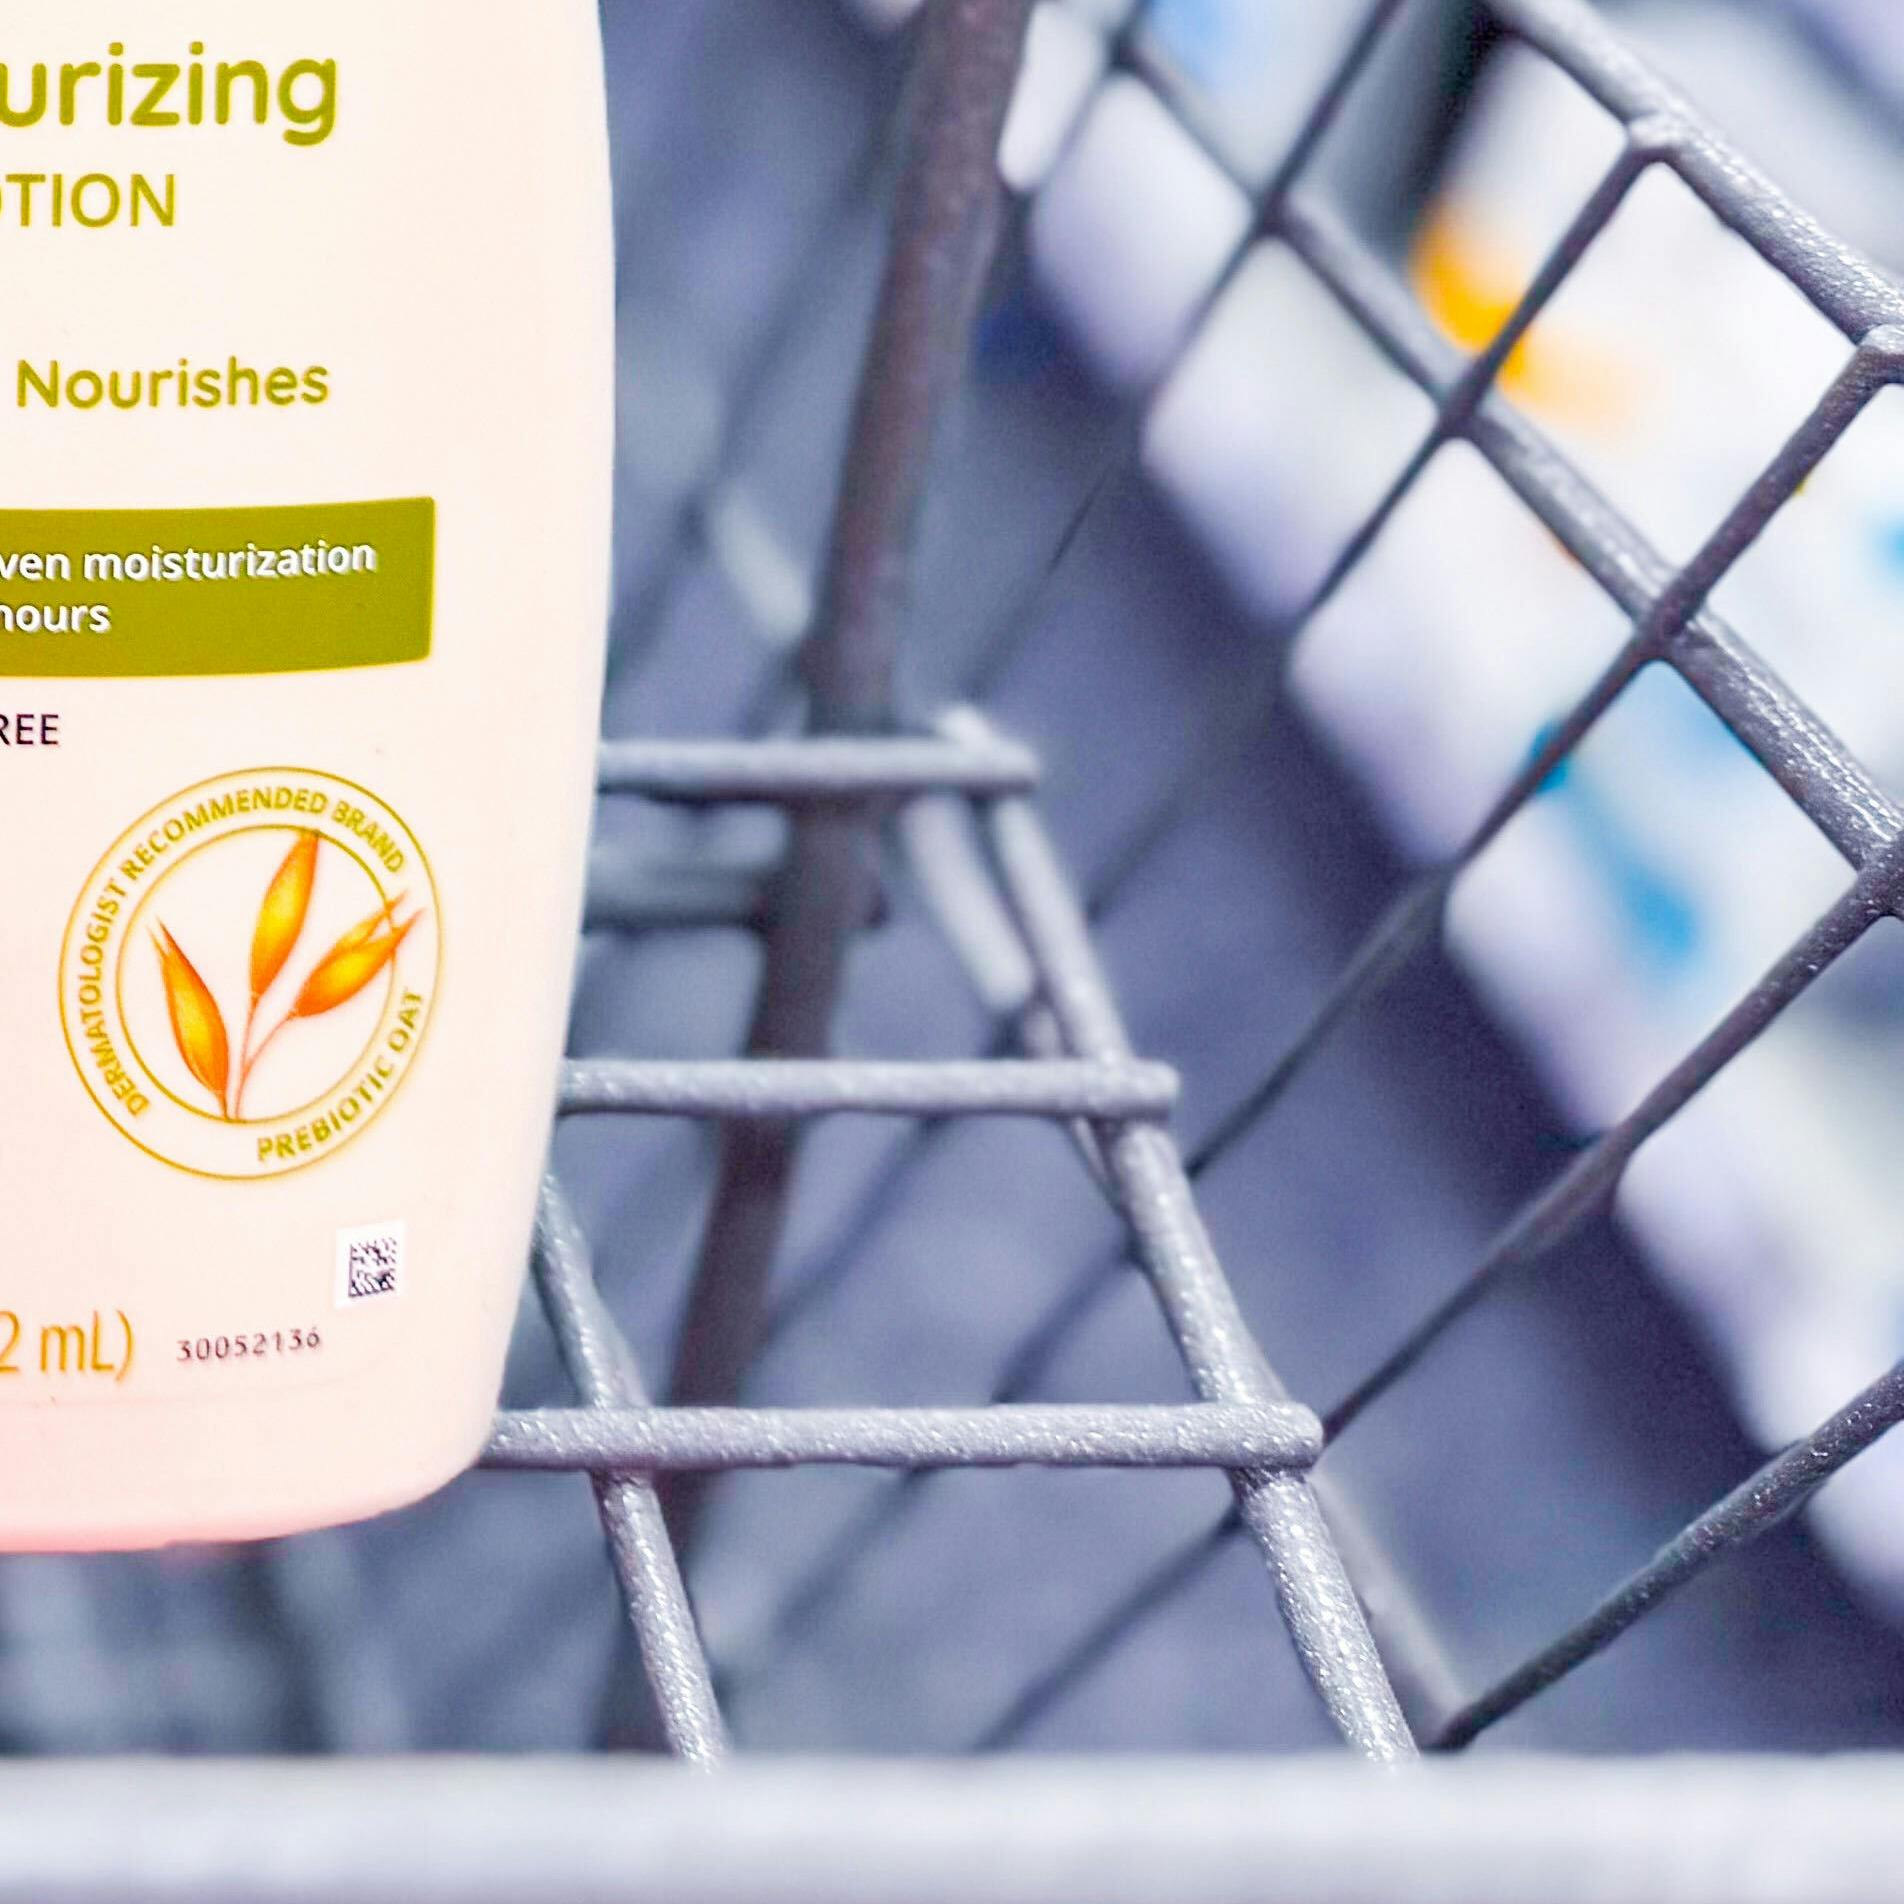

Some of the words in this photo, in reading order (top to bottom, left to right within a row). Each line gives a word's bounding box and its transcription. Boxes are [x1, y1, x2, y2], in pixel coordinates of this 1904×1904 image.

[17, 356, 329, 410] Nourishes
[85, 540, 376, 581] moisturization
[78, 877, 151, 1118] DERMATOLOGIST
[119, 786, 328, 881] RECOMMENDED
[332, 801, 405, 874] BRAND
[256, 1056, 394, 1162] PREBIOTIC
[391, 990, 423, 1053] OAT
[40, 1311, 134, 1381] mL)
[177, 1326, 320, 1361] 30052136
